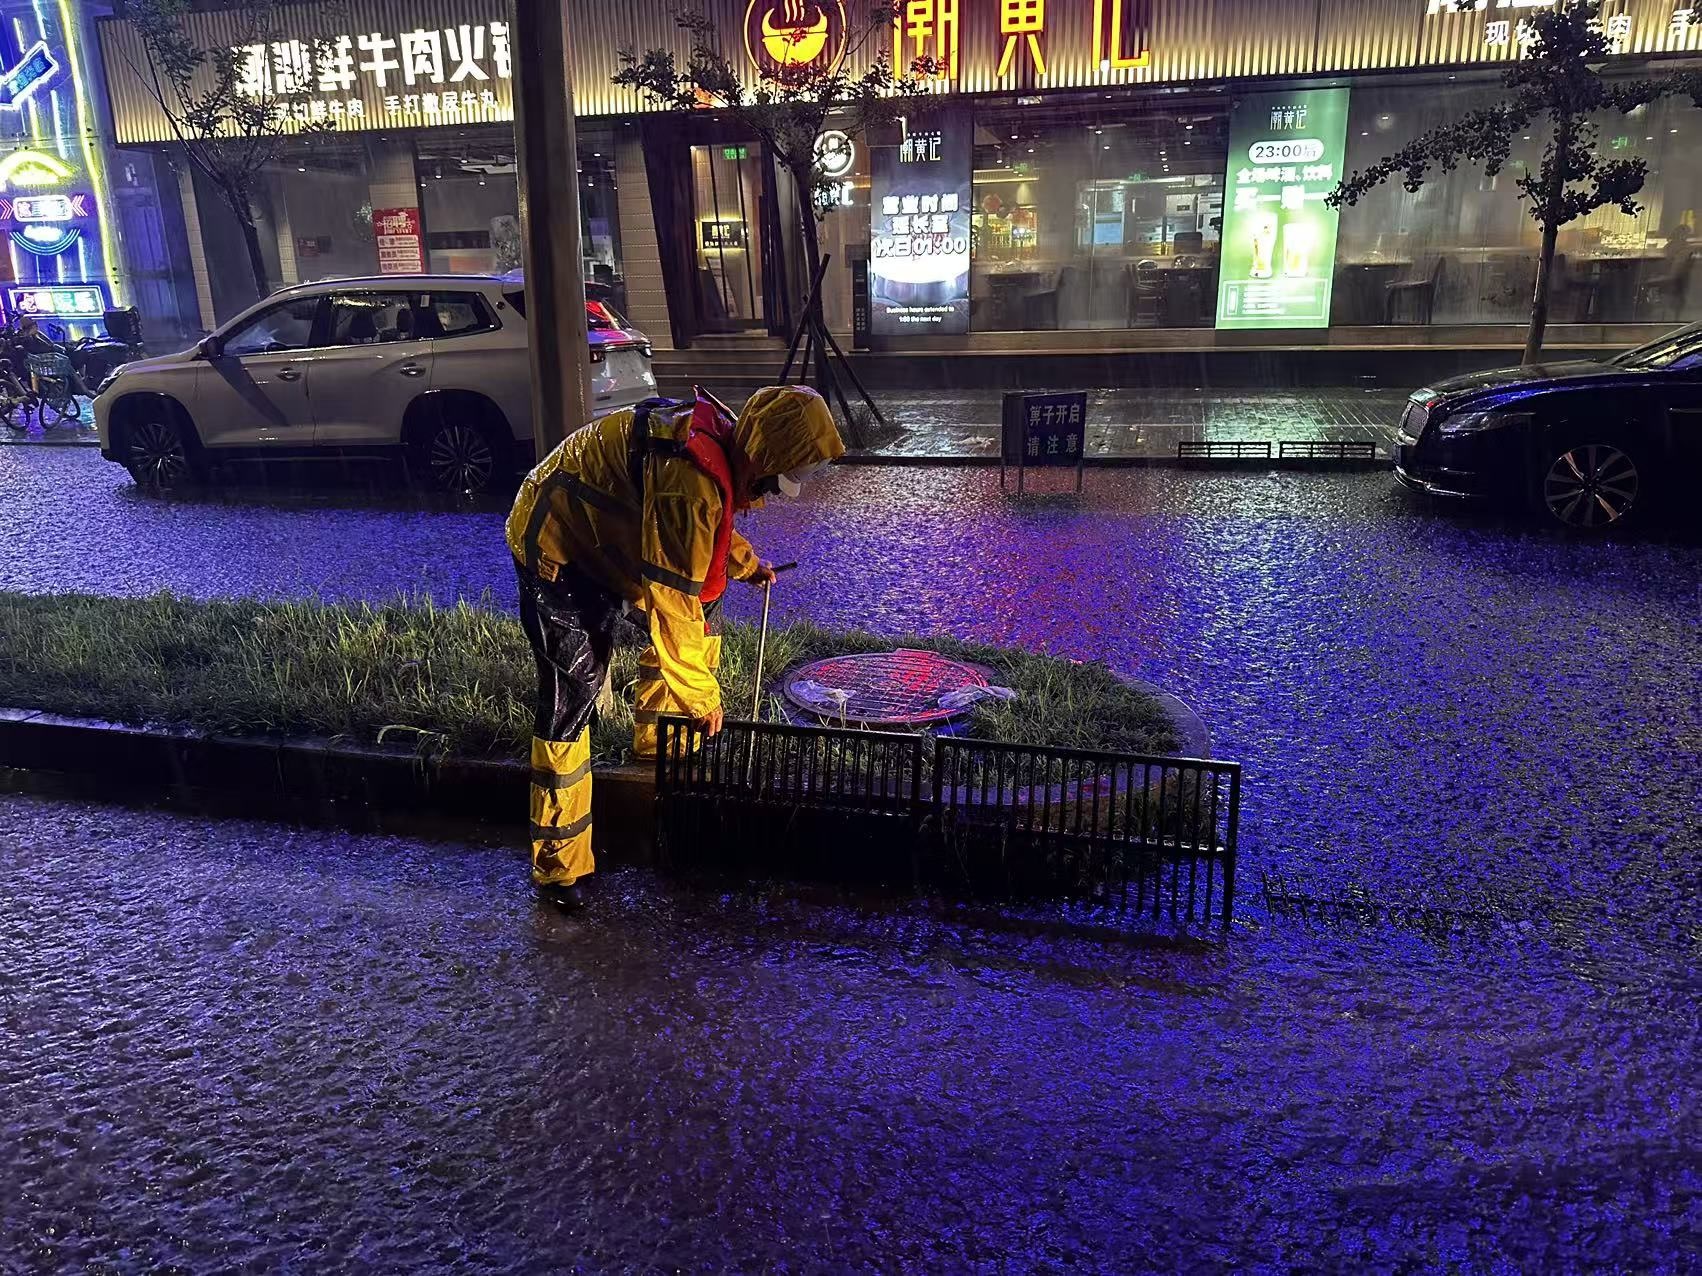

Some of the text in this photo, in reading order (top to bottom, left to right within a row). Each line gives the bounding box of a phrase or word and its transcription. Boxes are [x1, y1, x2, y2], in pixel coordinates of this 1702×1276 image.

[1270, 109, 1307, 130] 潮黄记
[900, 137, 941, 163] 潮黄记
[874, 236, 967, 258] 次日01:00
[1027, 433, 1079, 457] 请注意
